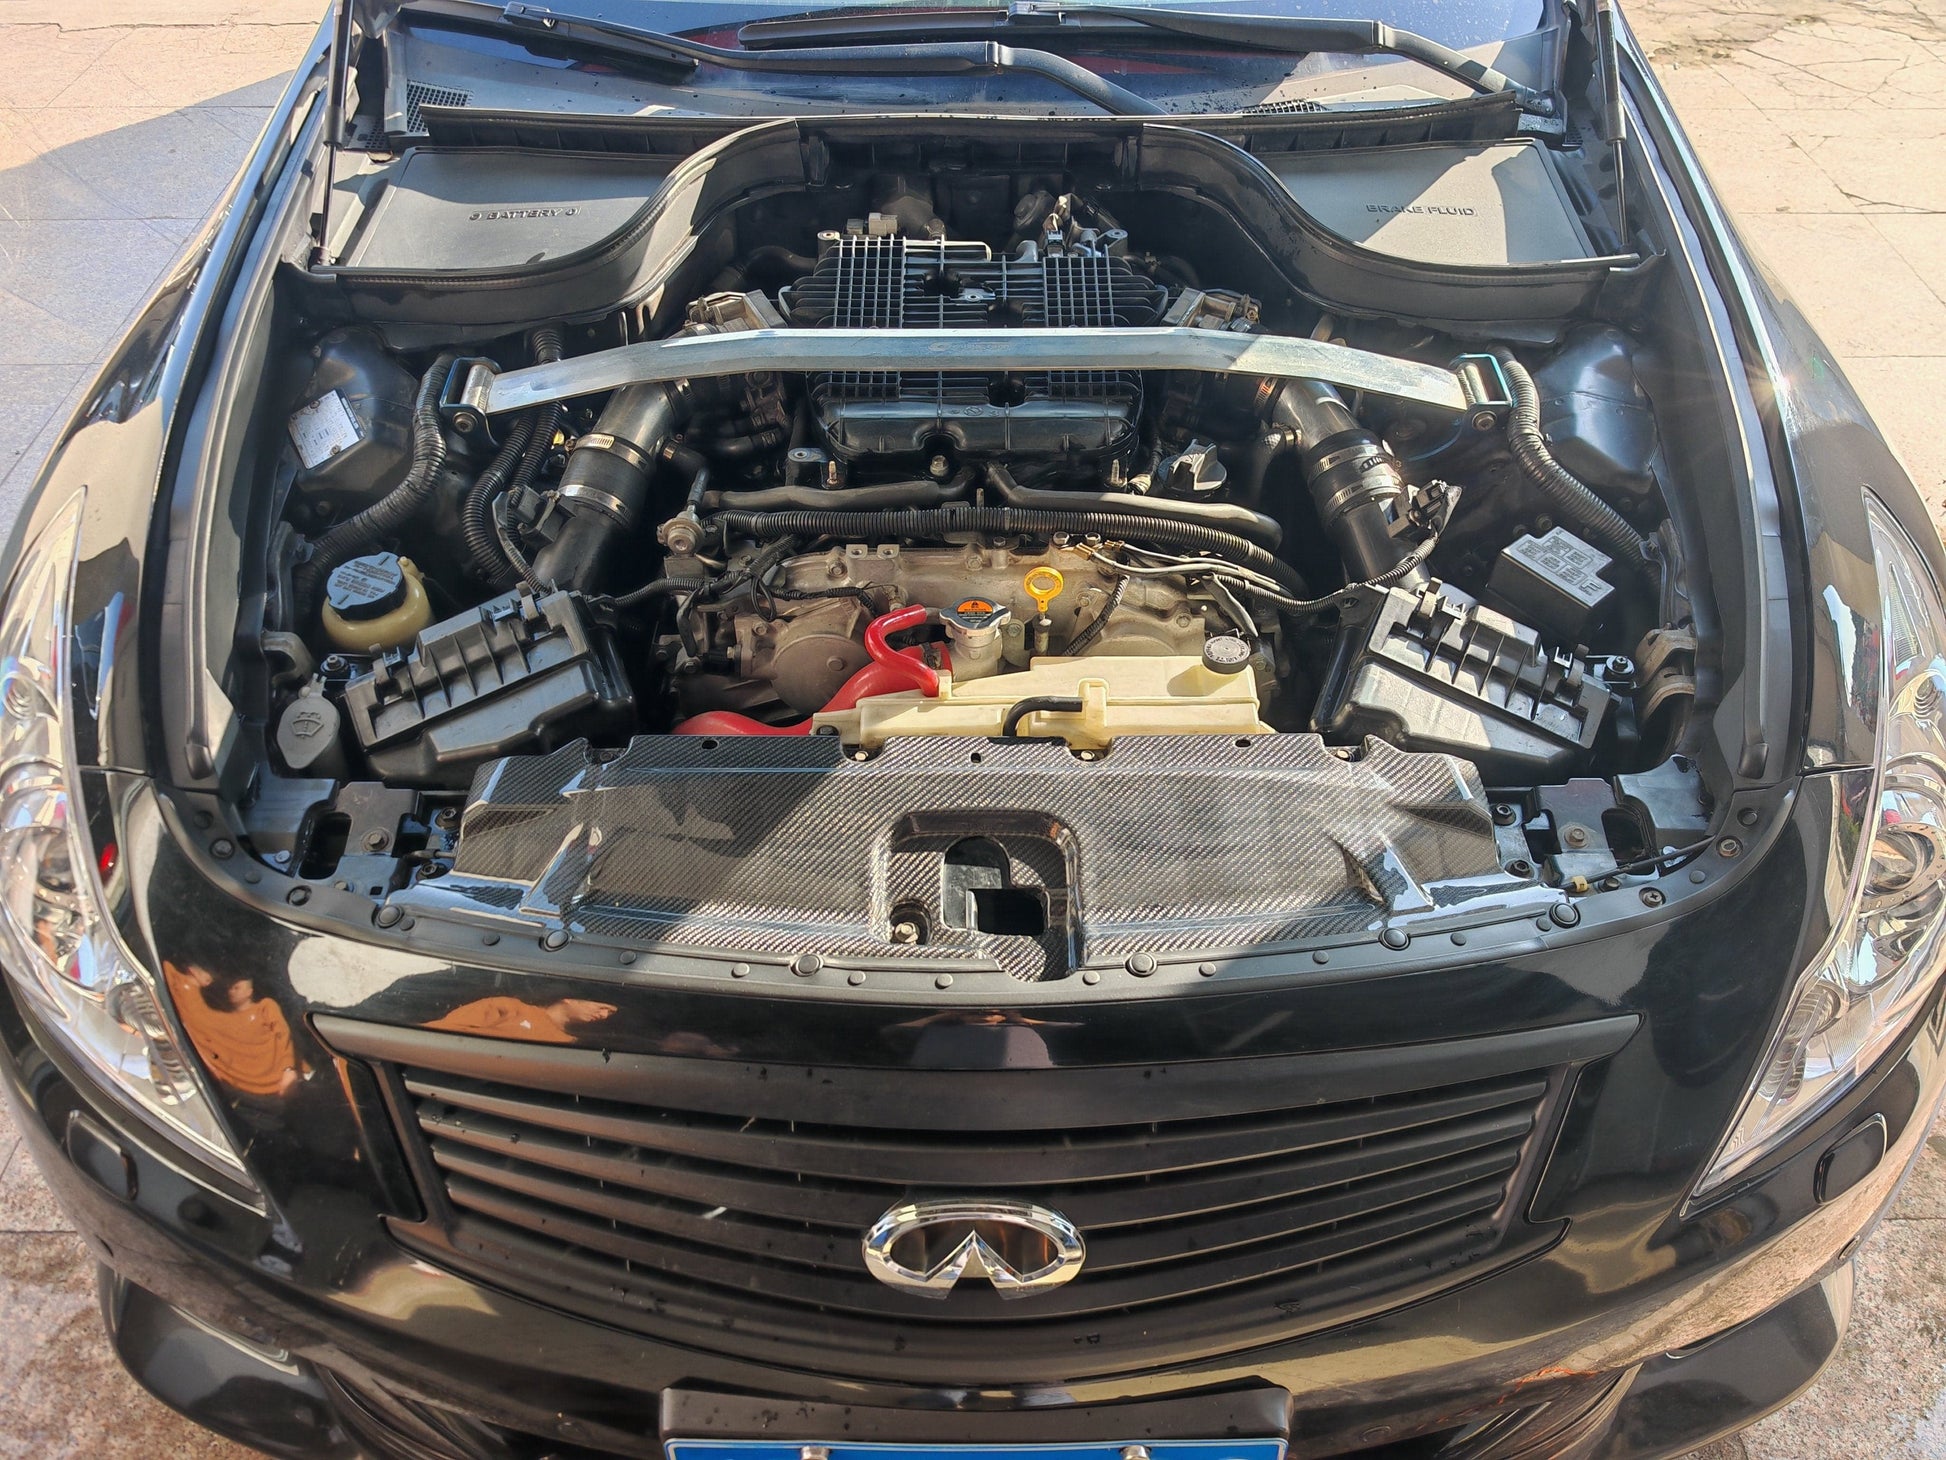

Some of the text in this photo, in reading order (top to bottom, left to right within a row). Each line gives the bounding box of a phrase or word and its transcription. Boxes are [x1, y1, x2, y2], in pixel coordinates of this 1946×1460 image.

[486, 208, 562, 220] BATTERY
[1366, 204, 1474, 216] BRAKE FLUID
